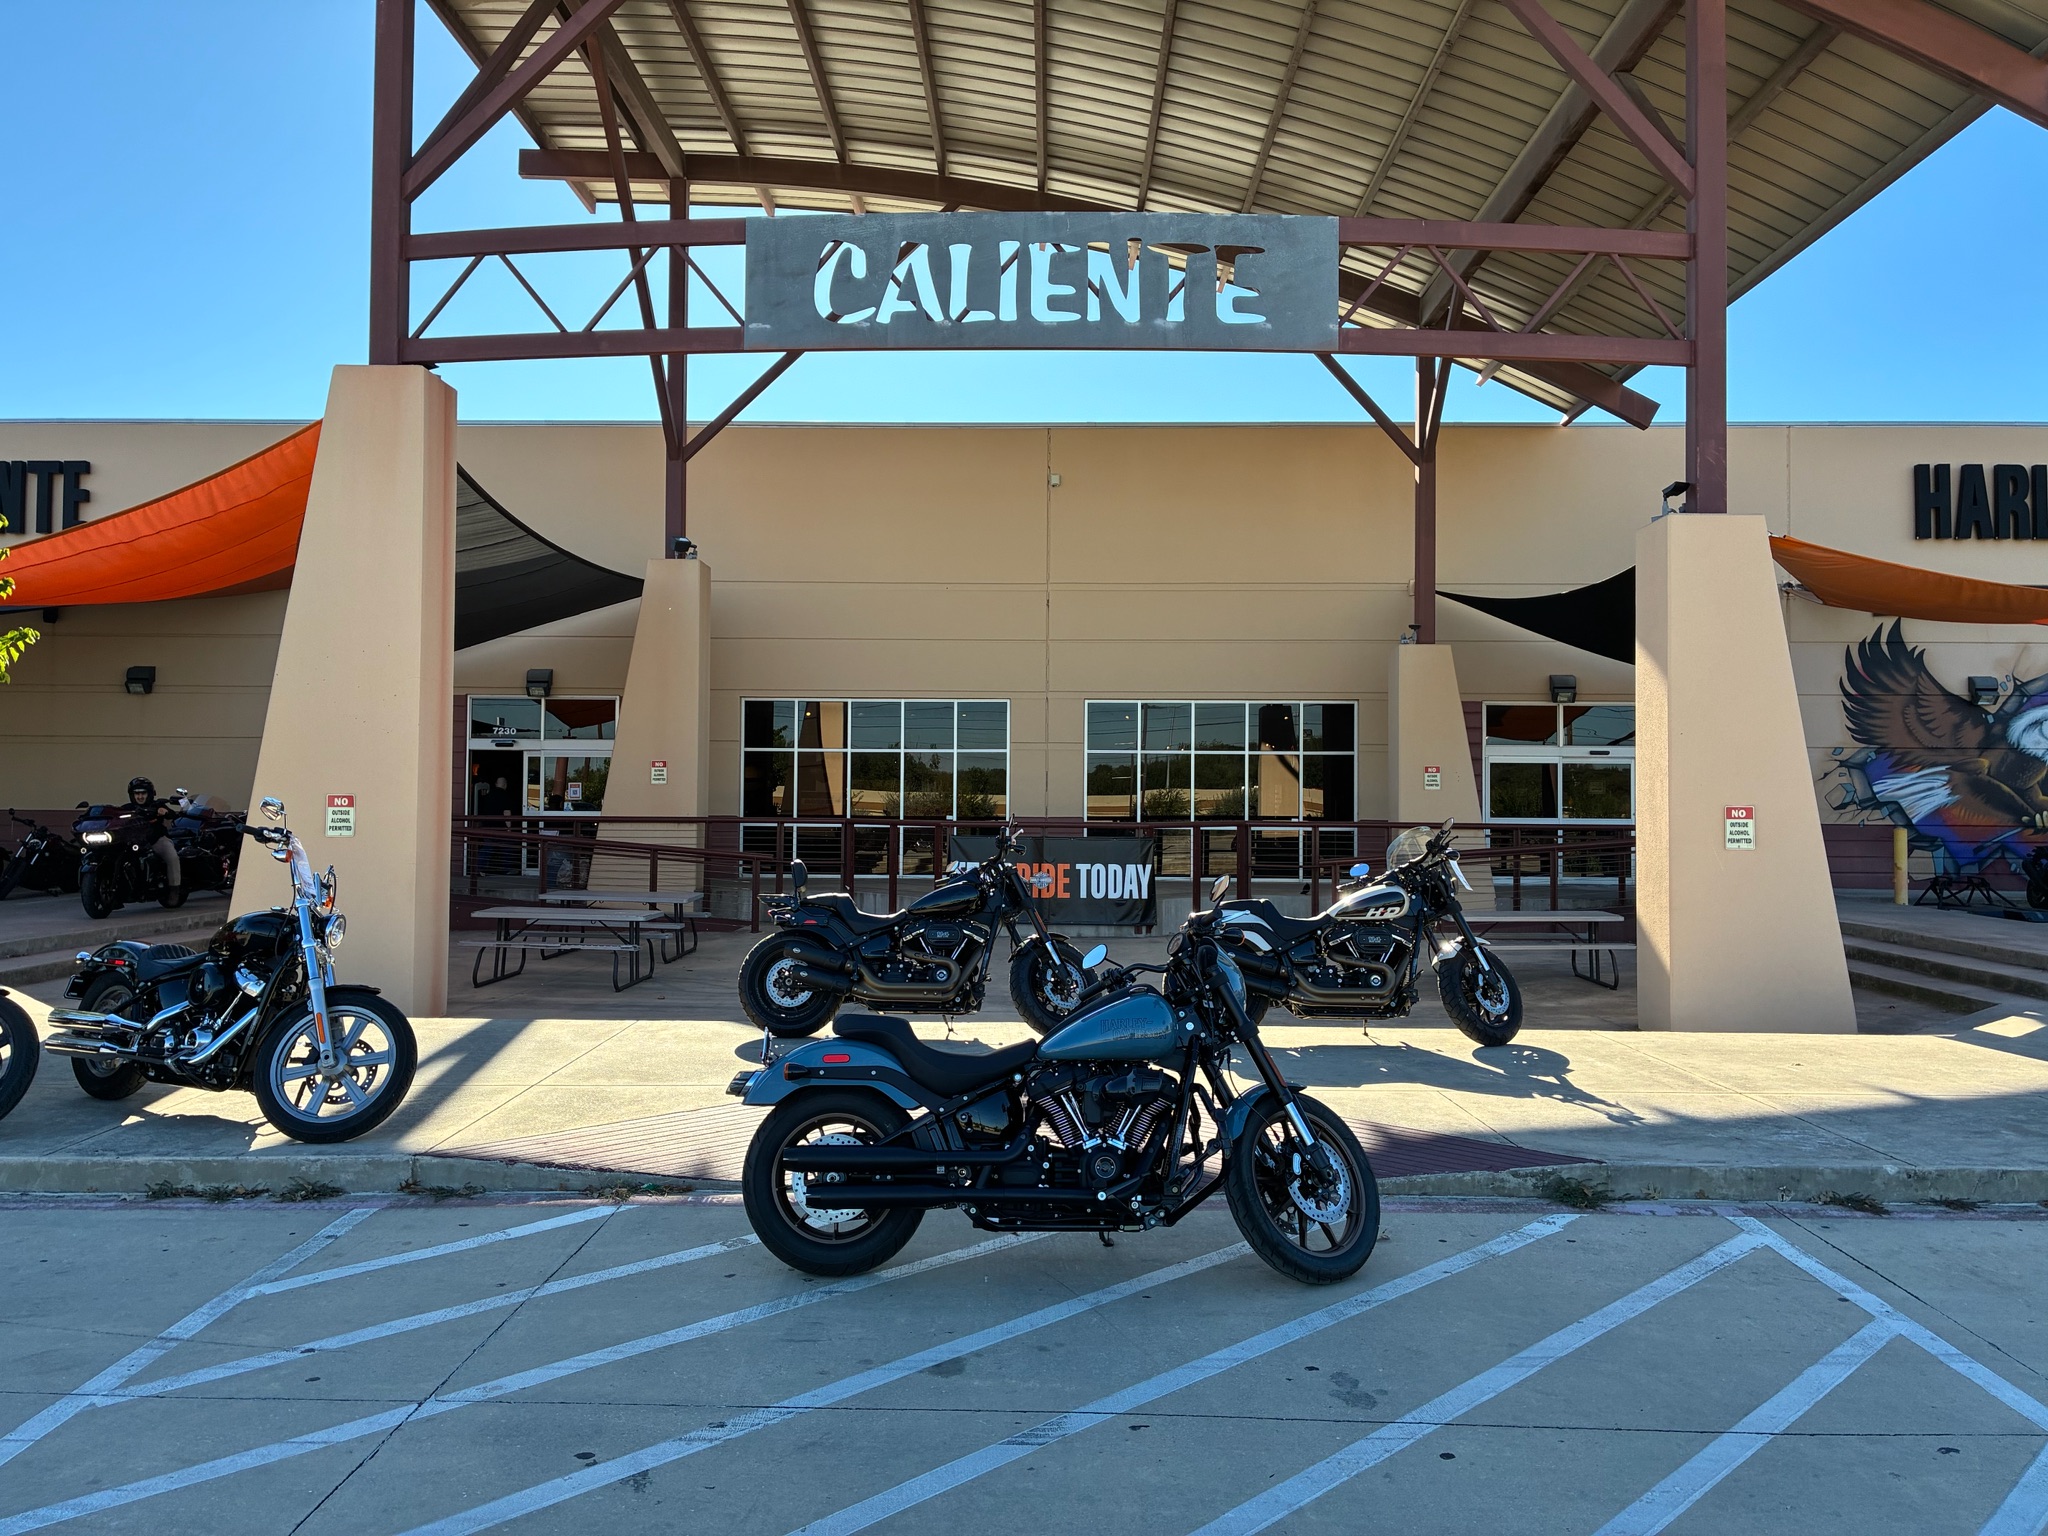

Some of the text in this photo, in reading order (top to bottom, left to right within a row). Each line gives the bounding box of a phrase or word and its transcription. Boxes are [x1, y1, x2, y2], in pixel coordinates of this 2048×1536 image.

[813, 237, 1267, 324] CALIENTE
[493, 727, 517, 735] 7230
[334, 797, 349, 806] NO
[1731, 809, 1747, 818] NO
[1075, 863, 1153, 900] TODAY
